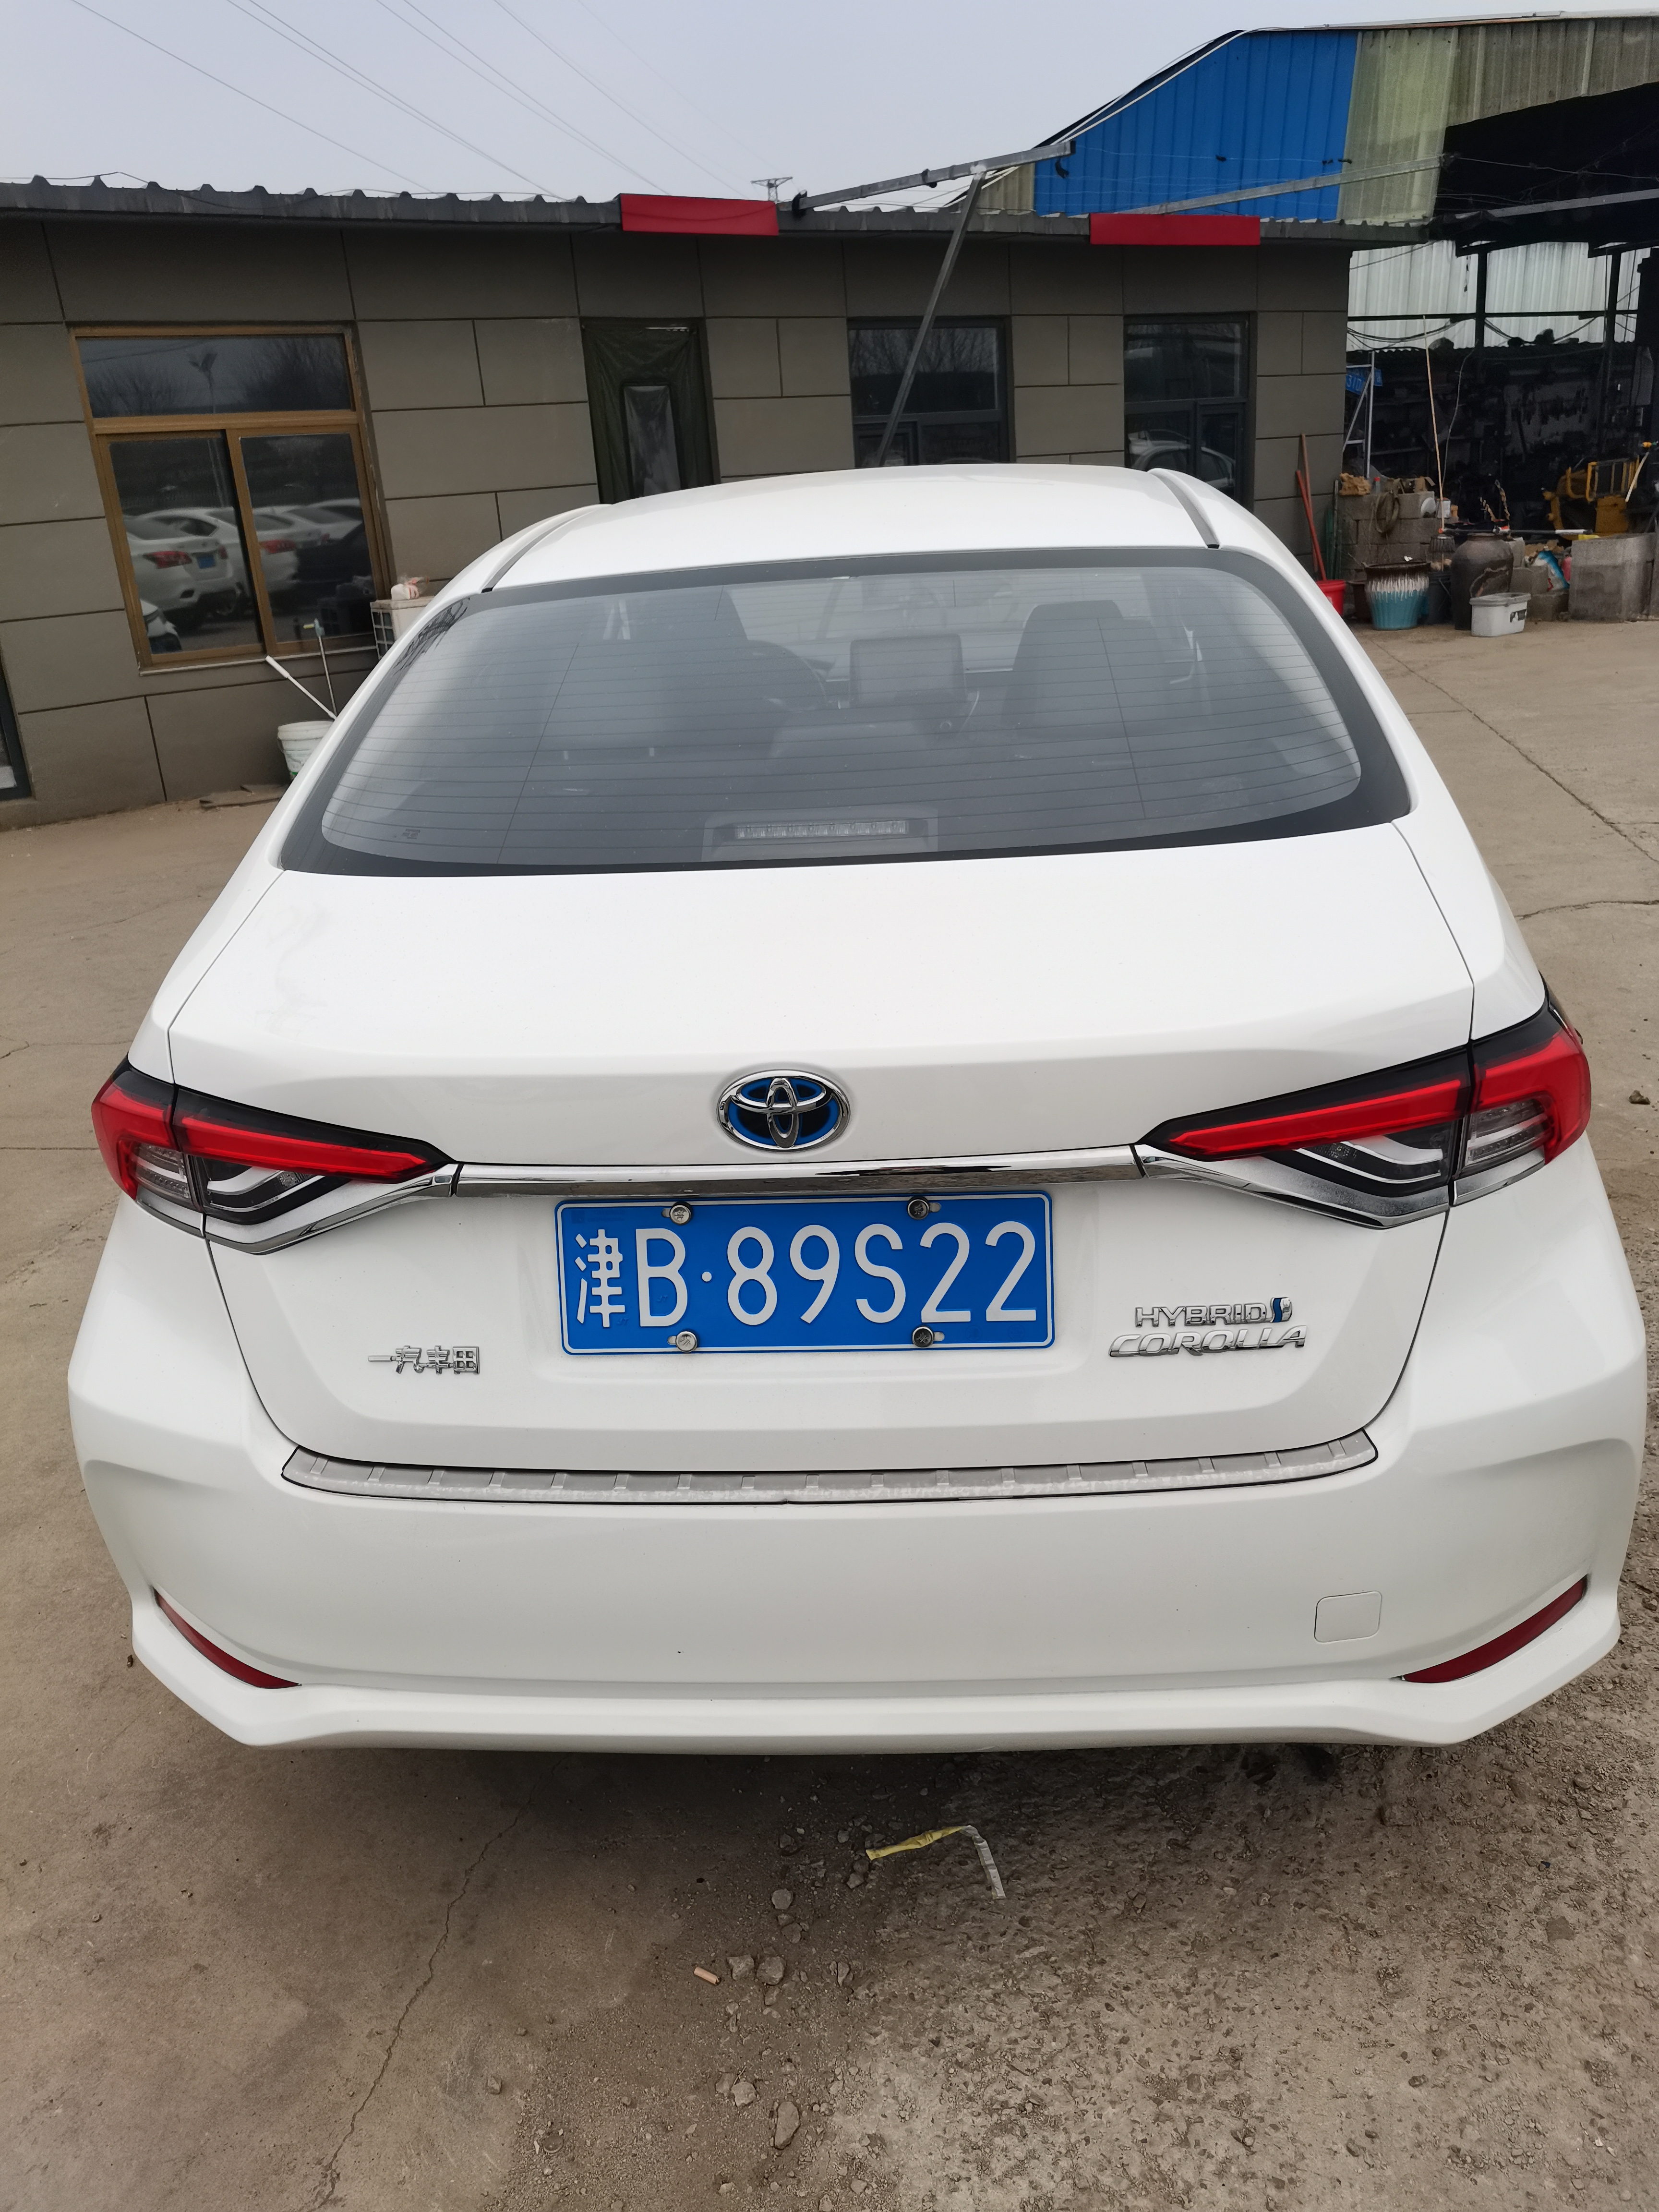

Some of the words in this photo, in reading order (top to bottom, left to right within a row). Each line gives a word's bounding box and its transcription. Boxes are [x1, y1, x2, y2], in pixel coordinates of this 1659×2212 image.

[575, 1221, 1037, 1328] 津B·89S22
[1135, 1303, 1267, 1327] HYBRID
[1108, 1325, 1307, 1358] COROLLA
